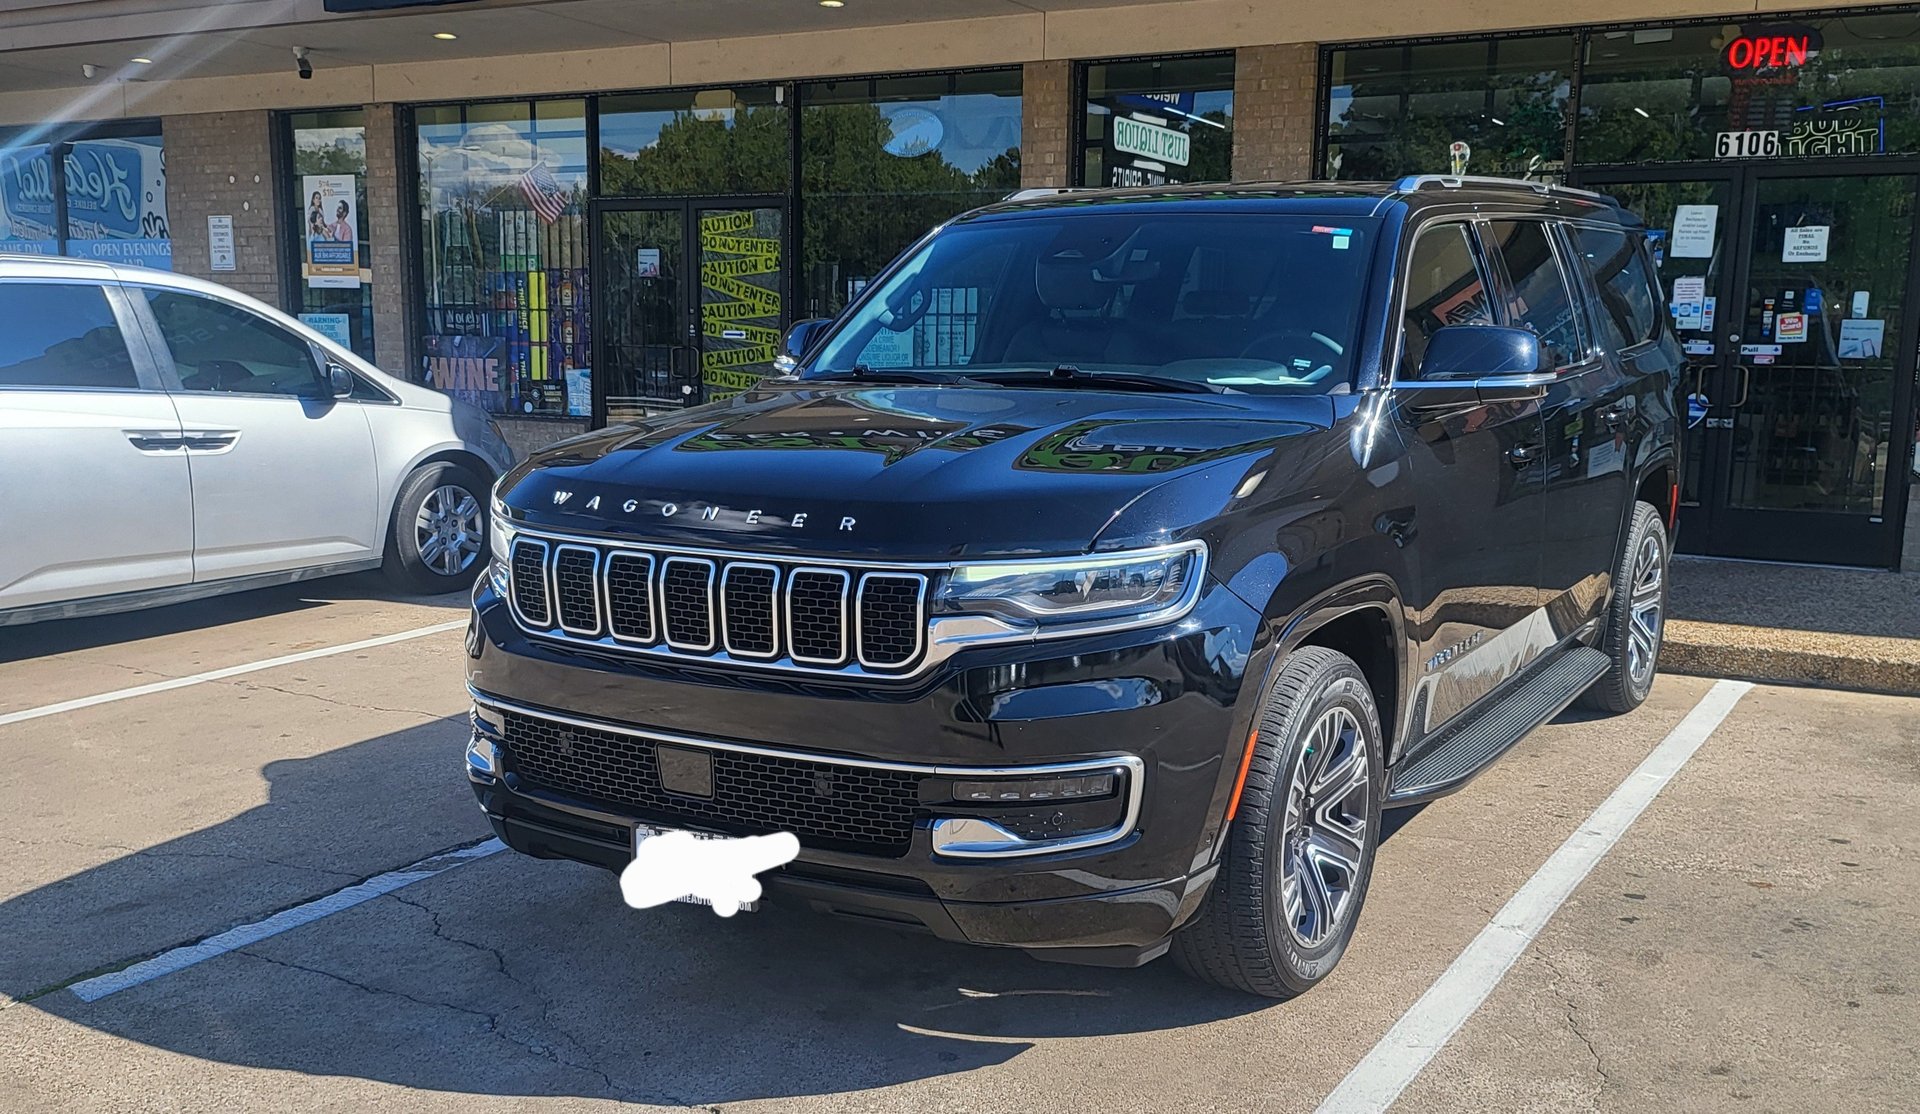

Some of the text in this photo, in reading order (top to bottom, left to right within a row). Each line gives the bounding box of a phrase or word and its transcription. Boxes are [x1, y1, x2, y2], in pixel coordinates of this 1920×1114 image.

[1728, 35, 1809, 69] OPEN
[1717, 132, 1777, 158] 6106
[703, 213, 752, 233] AUTION
[92, 242, 172, 257] OPEN EVENINGS
[702, 235, 718, 250] DO
[743, 240, 780, 255] ENTER
[702, 271, 719, 287] DO
[743, 285, 780, 309] ENTER
[701, 303, 756, 319] CAUTION
[706, 346, 766, 367] CAUTION
[430, 356, 499, 393] WINE
[553, 491, 856, 531] WAGONEER
